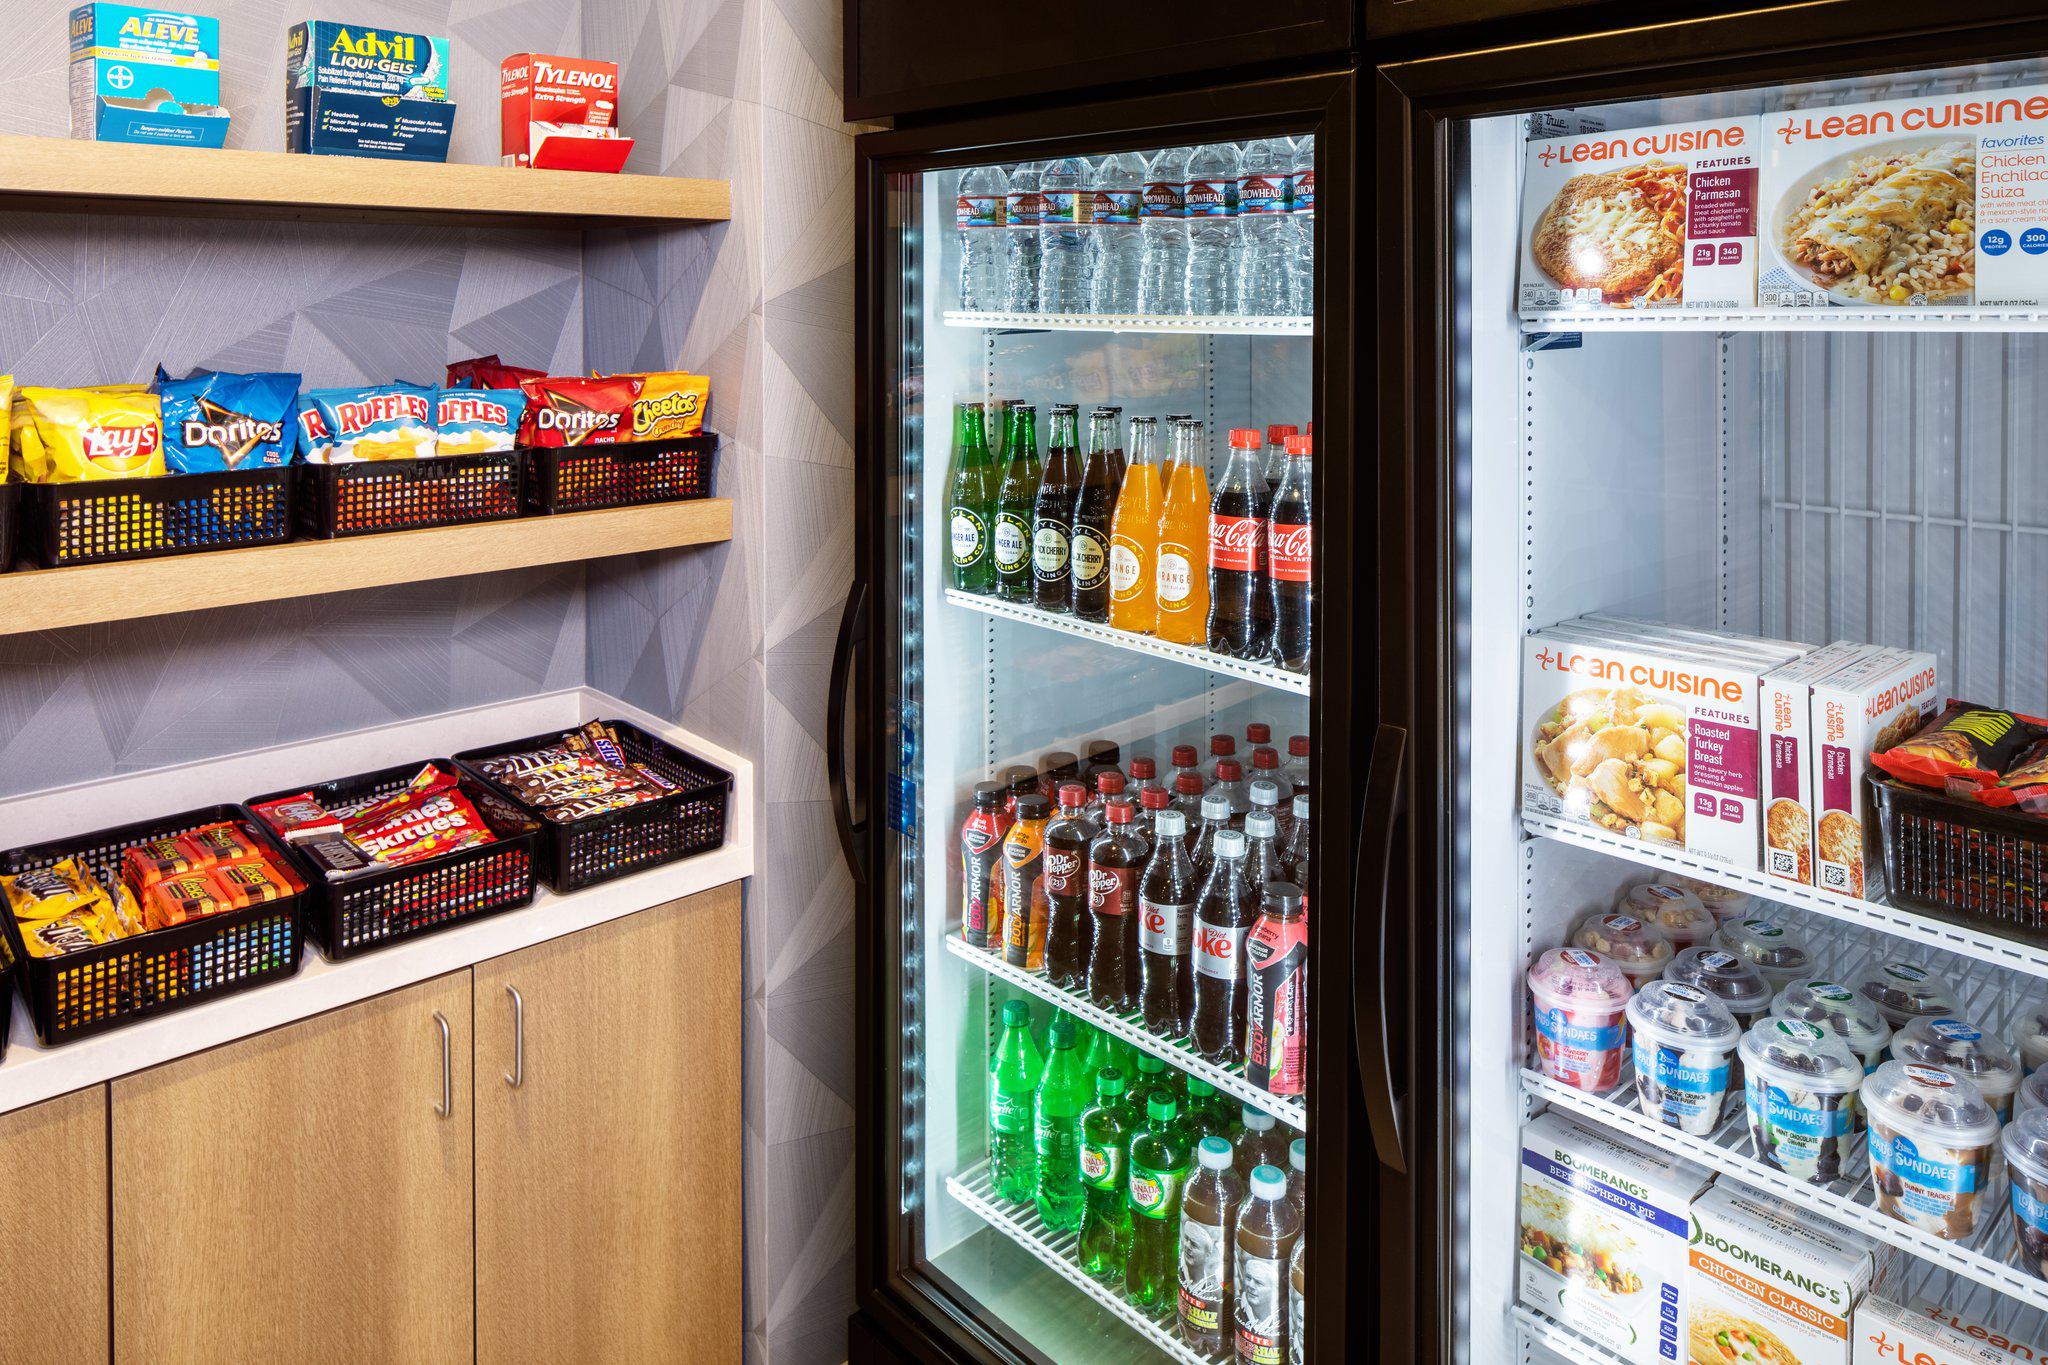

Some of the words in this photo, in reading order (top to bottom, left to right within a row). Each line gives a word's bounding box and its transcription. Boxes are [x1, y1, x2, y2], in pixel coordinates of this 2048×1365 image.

[72, 16, 94, 36] ALEVE
[119, 17, 199, 43] ALEVE
[329, 28, 416, 61] Advil
[502, 66, 529, 84] TYLENOL
[534, 61, 615, 90] TYLENOL
[534, 93, 554, 101] Extra
[555, 95, 586, 104] Strength
[329, 126, 358, 134] Toothache
[427, 127, 447, 135] Cramps
[1981, 134, 2044, 148] favorites
[1696, 156, 1751, 168] FEATURES
[1981, 154, 2046, 168] Chicken
[1696, 176, 1731, 188] Chicken
[1696, 189, 1741, 200] Parmesan
[1981, 187, 2025, 199] Suiza
[1698, 222, 1720, 230] chunky
[1708, 214, 1734, 223] spaghetti
[1988, 236, 2004, 245] 12g
[1697, 250, 1711, 258] 21g
[1764, 293, 1777, 301] 300
[340, 394, 428, 433] RUFFLES
[438, 400, 507, 425] UFFLES
[538, 408, 621, 430] Doritos
[184, 420, 283, 447] Doritos
[652, 418, 685, 438] Crunchy
[266, 450, 281, 459] COOL
[964, 533, 976, 542] ALE
[1012, 540, 1022, 550] ALE
[1046, 546, 1067, 556] CHERRY
[1082, 554, 1102, 564] CHERRY
[1695, 707, 1750, 724] FEATURES
[1694, 724, 1730, 741] Roasted
[1694, 736, 1724, 755] Turkey
[1785, 742, 1793, 764] Chicken
[1694, 750, 1724, 766] Breast
[1775, 739, 1783, 769] Parmesan
[1827, 750, 1835, 780] Parmesan
[1837, 752, 1846, 776] Chicken
[1694, 770, 1720, 782] dressing
[1708, 767, 1727, 776] savory
[1728, 770, 1743, 779] herb
[1694, 777, 1722, 788] cinnamon
[1723, 783, 1744, 792] apples
[1699, 798, 1712, 808] 13g
[1724, 803, 1739, 813] 300
[360, 811, 470, 857] Skittles
[970, 857, 984, 930] BODYARMOR
[1011, 872, 1022, 946] BODYARMOR
[1146, 903, 1160, 914] Diet
[1208, 928, 1227, 939] Diet
[1252, 972, 1264, 1066] BODYARMOR
[1551, 1022, 1598, 1041] SUNDAES
[1659, 1063, 1710, 1084] SUNDAES
[1768, 1101, 1825, 1126] SUNDAES
[1776, 1127, 1788, 1137] MINT
[1789, 1132, 1818, 1144] CHOCOLATE
[1086, 1166, 1100, 1174] DRY
[1896, 1151, 1958, 1182] SUNDAES
[1554, 1149, 1649, 1201] BOOMERANG'S
[1131, 1180, 1162, 1194] CANADA
[1927, 1190, 1951, 1200] TRACKS
[1137, 1192, 1153, 1202] DRY
[1638, 1206, 1656, 1222] PIE
[1704, 1232, 1842, 1305] BOOMERANG'S
[1181, 1290, 1202, 1308] LITE
[1698, 1256, 1766, 1299] CHICKEN
[1768, 1290, 1835, 1330] CLASSIC
[1245, 1330, 1270, 1346] LITE
[1821, 1330, 1839, 1343] pastry
